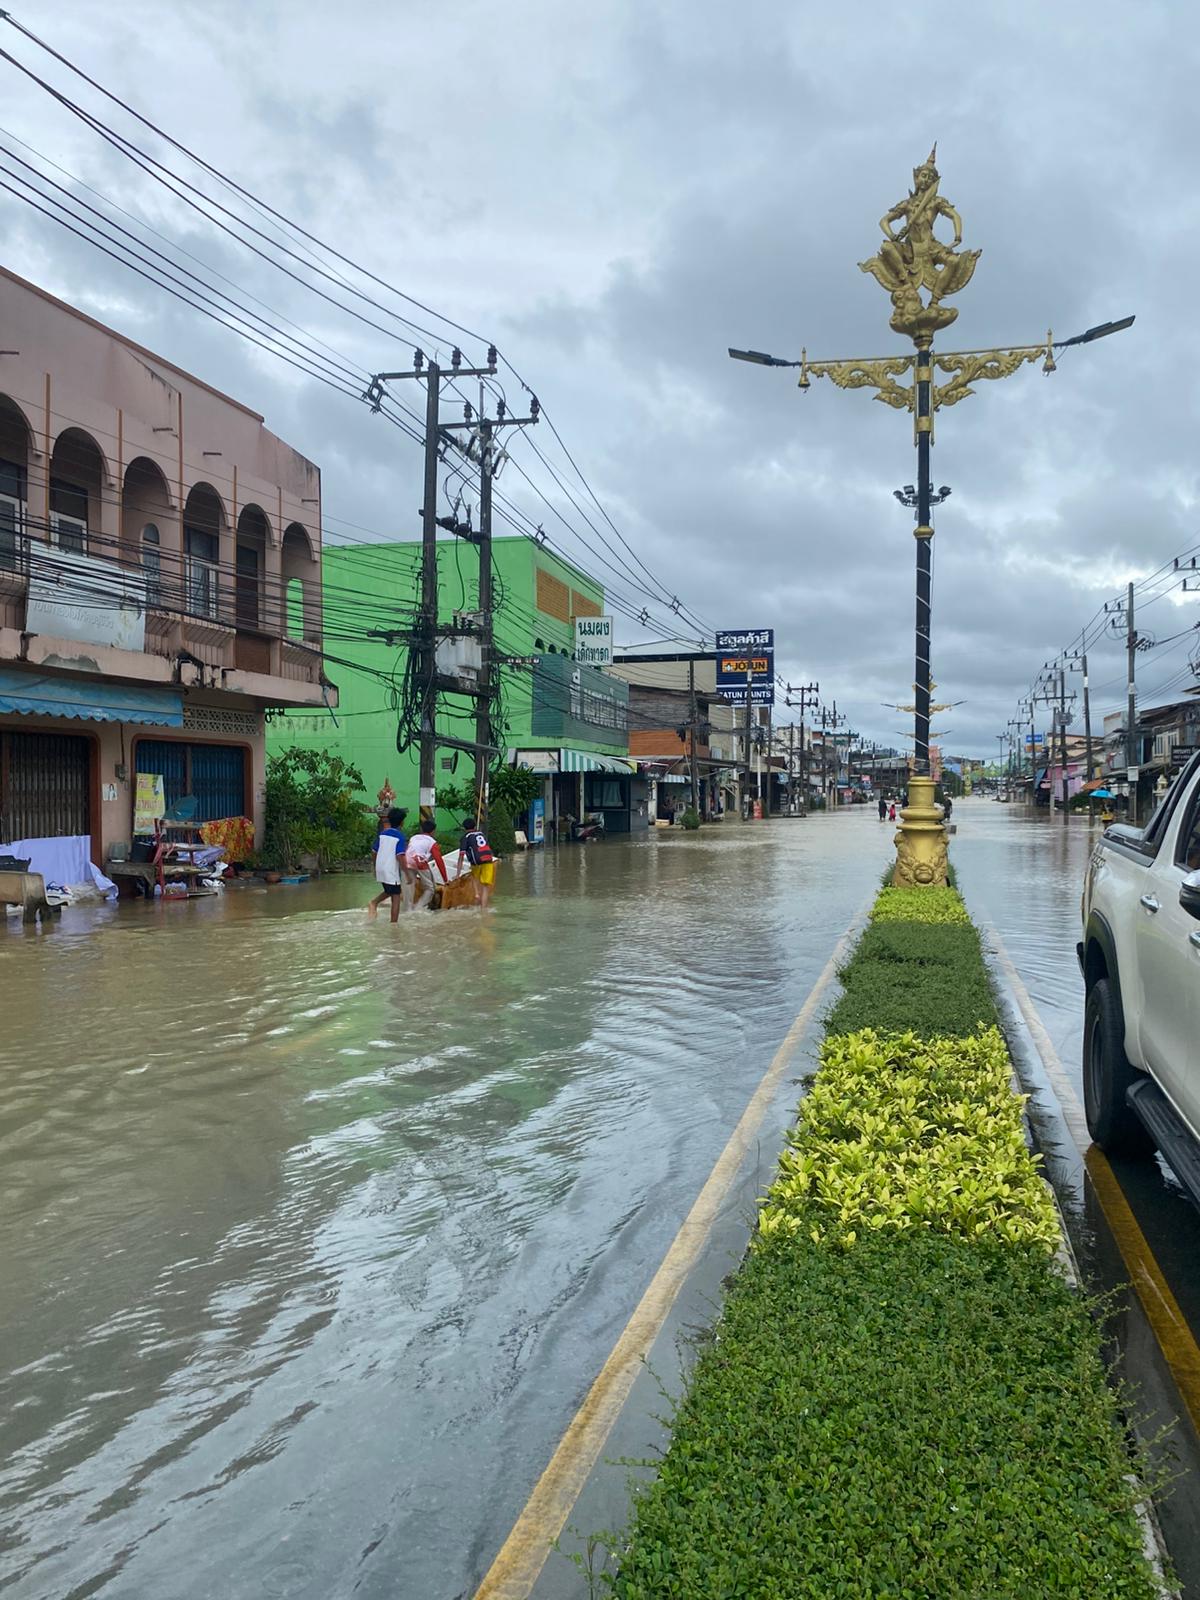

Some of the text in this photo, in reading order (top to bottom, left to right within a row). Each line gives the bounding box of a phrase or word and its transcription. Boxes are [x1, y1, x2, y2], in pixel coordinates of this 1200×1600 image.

[578, 622, 610, 636] นมผง
[577, 641, 609, 662] เด็กทารก
[734, 661, 765, 671] JOUN
[476, 835, 486, 847] 8
